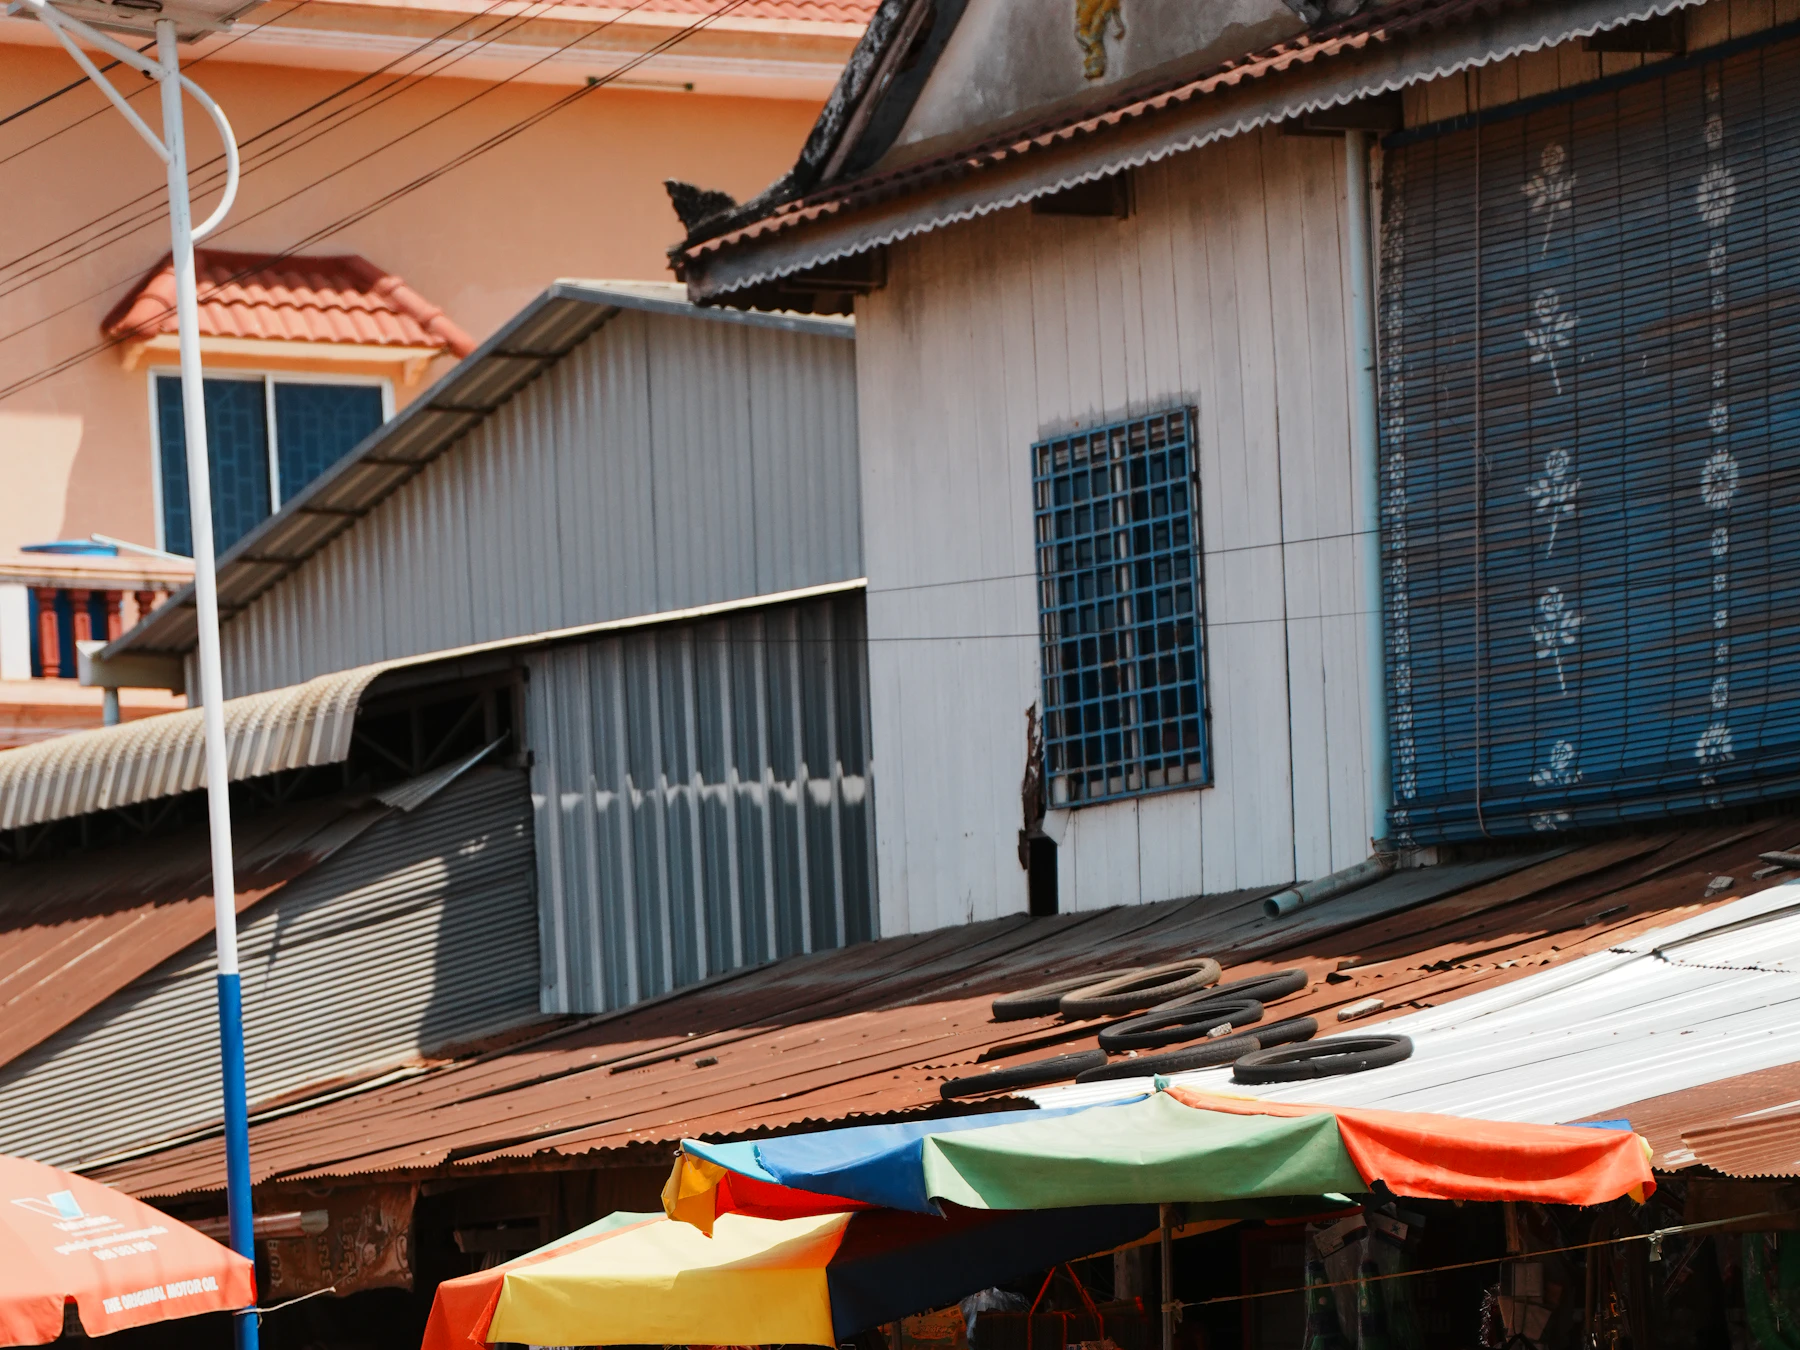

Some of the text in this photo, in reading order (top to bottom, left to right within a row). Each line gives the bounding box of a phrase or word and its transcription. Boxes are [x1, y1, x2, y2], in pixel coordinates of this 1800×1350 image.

[102, 1276, 219, 1315] THE ORIGINAL MOTOR OIL
